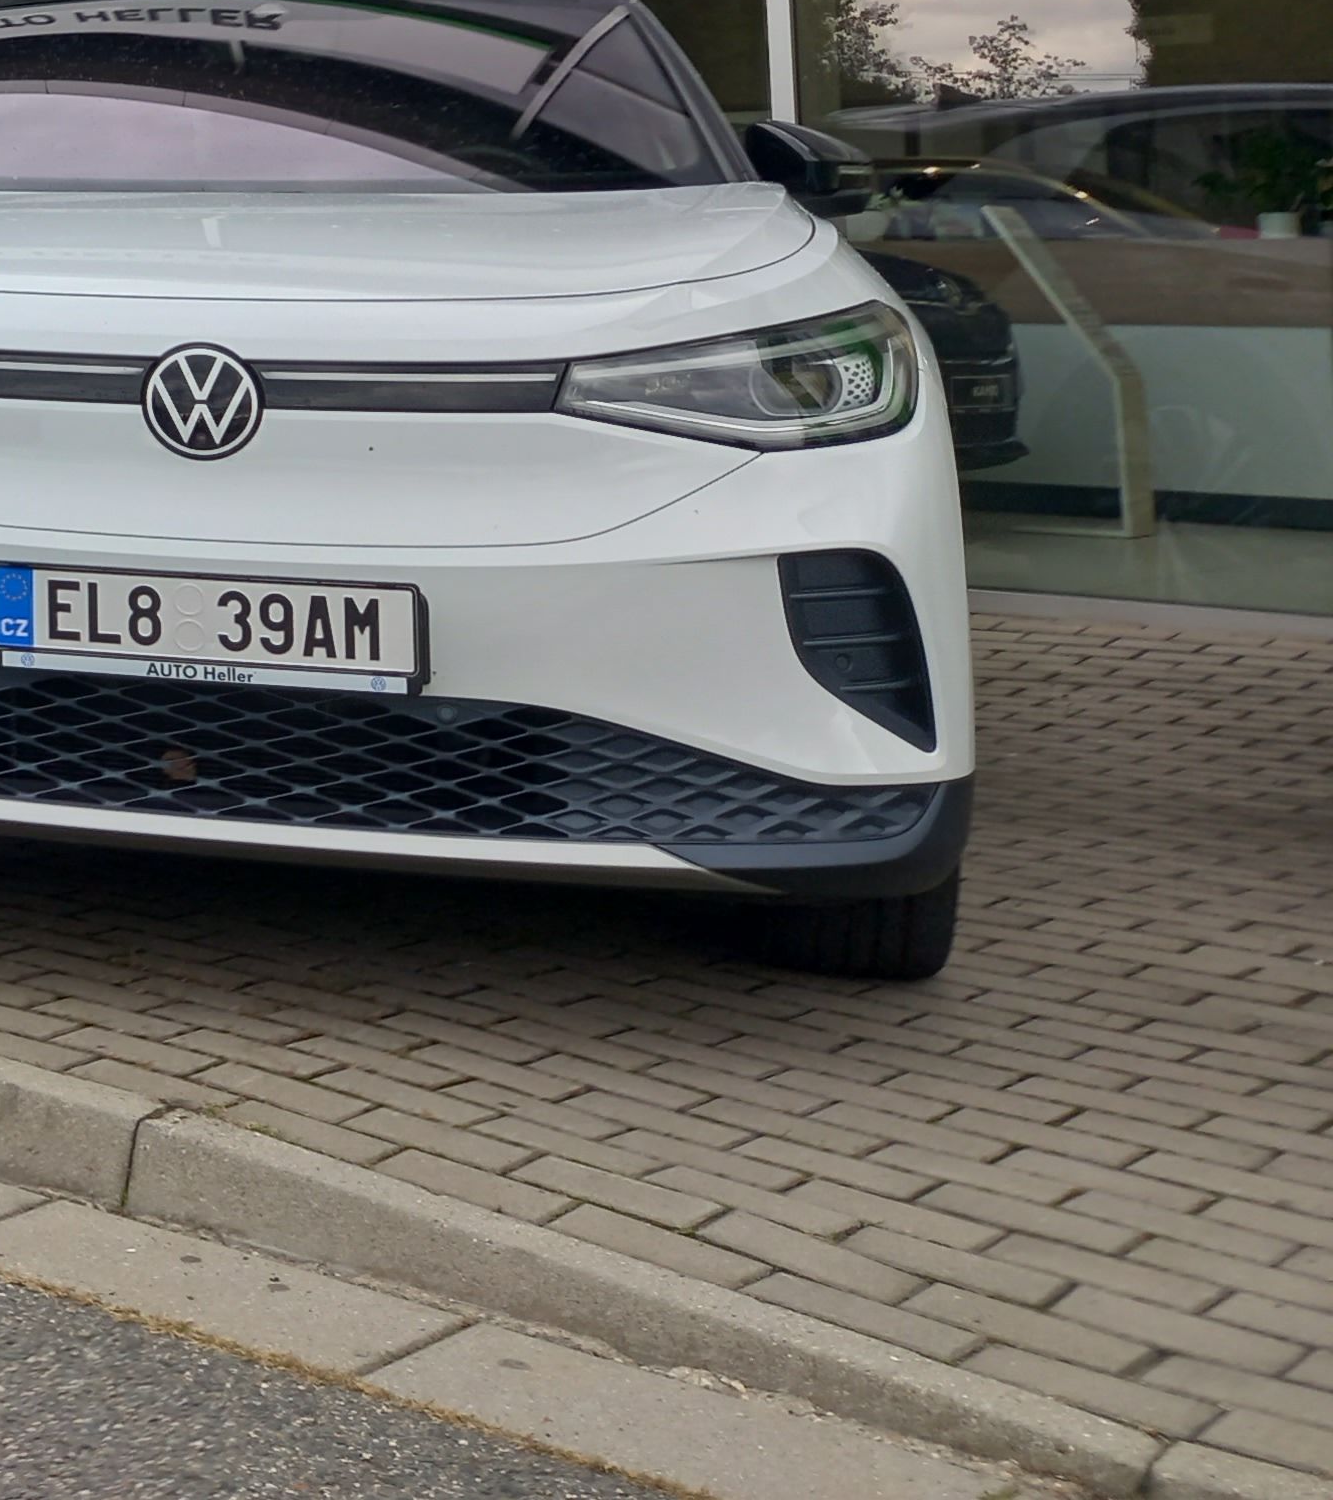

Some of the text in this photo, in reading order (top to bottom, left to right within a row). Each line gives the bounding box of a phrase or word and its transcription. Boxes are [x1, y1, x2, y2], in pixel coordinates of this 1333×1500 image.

[1, 618, 29, 637] CZ
[47, 579, 380, 661] EL8 39AM
[146, 662, 254, 683] AUTO Heller
